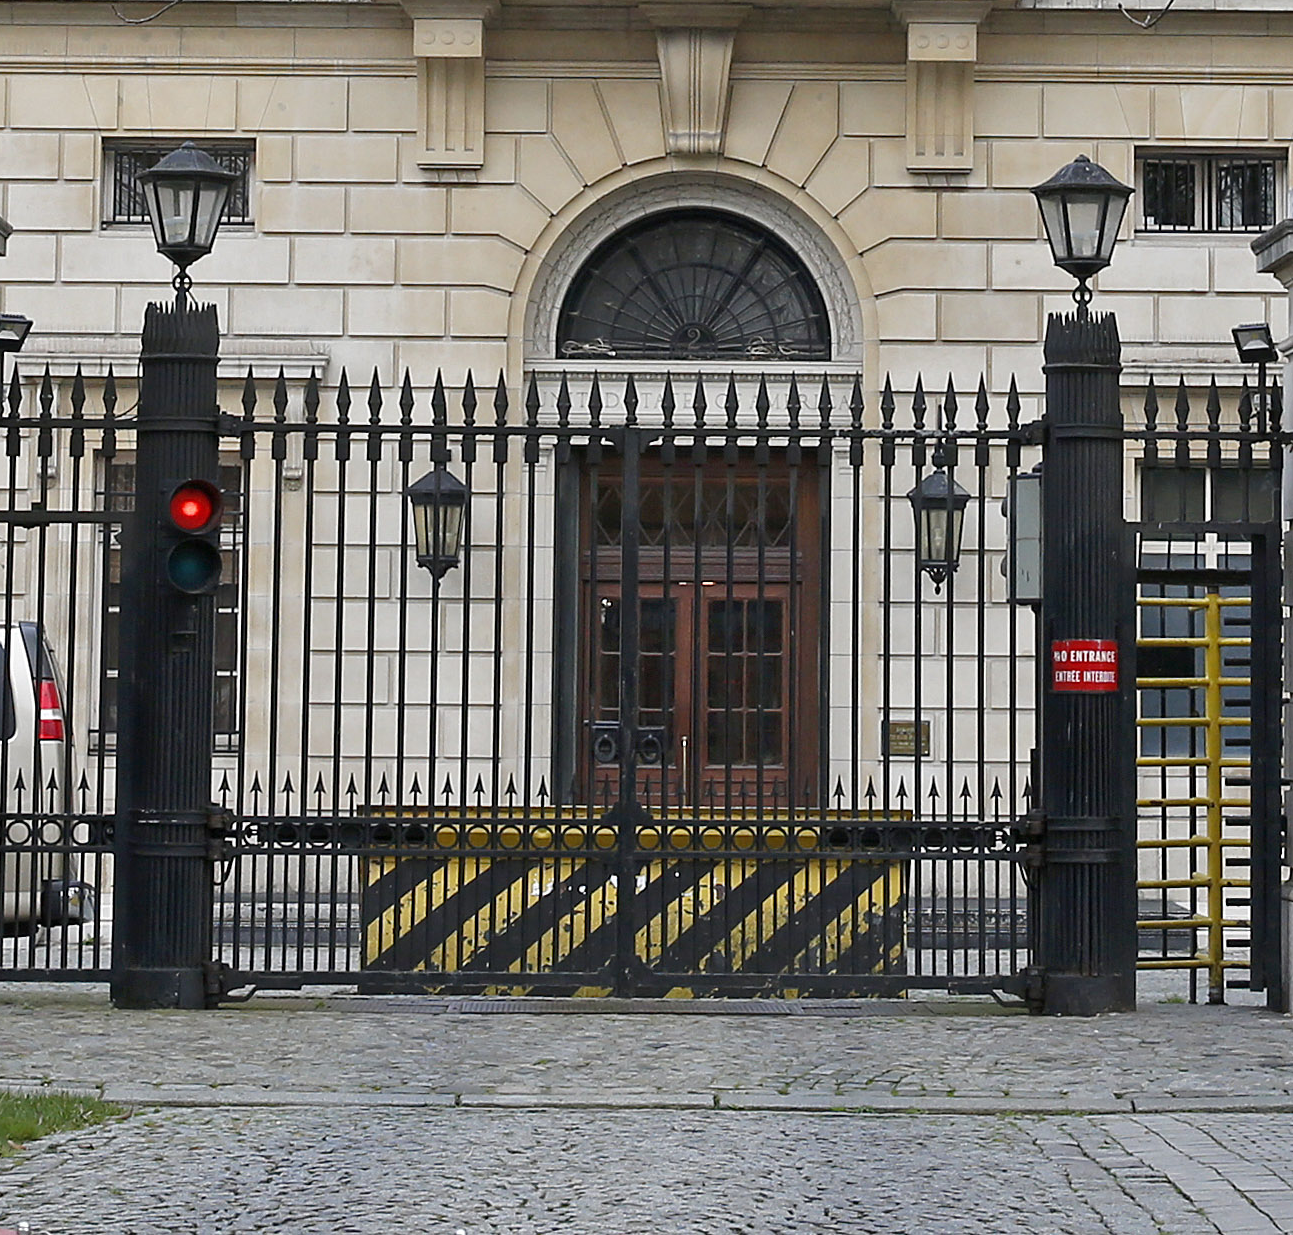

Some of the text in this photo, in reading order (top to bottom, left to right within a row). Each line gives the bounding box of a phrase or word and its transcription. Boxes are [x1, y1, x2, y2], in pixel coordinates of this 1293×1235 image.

[1053, 650, 1116, 663] NO ENTRANCE
[1055, 670, 1116, 683] ENTRÉE INTERDITE
